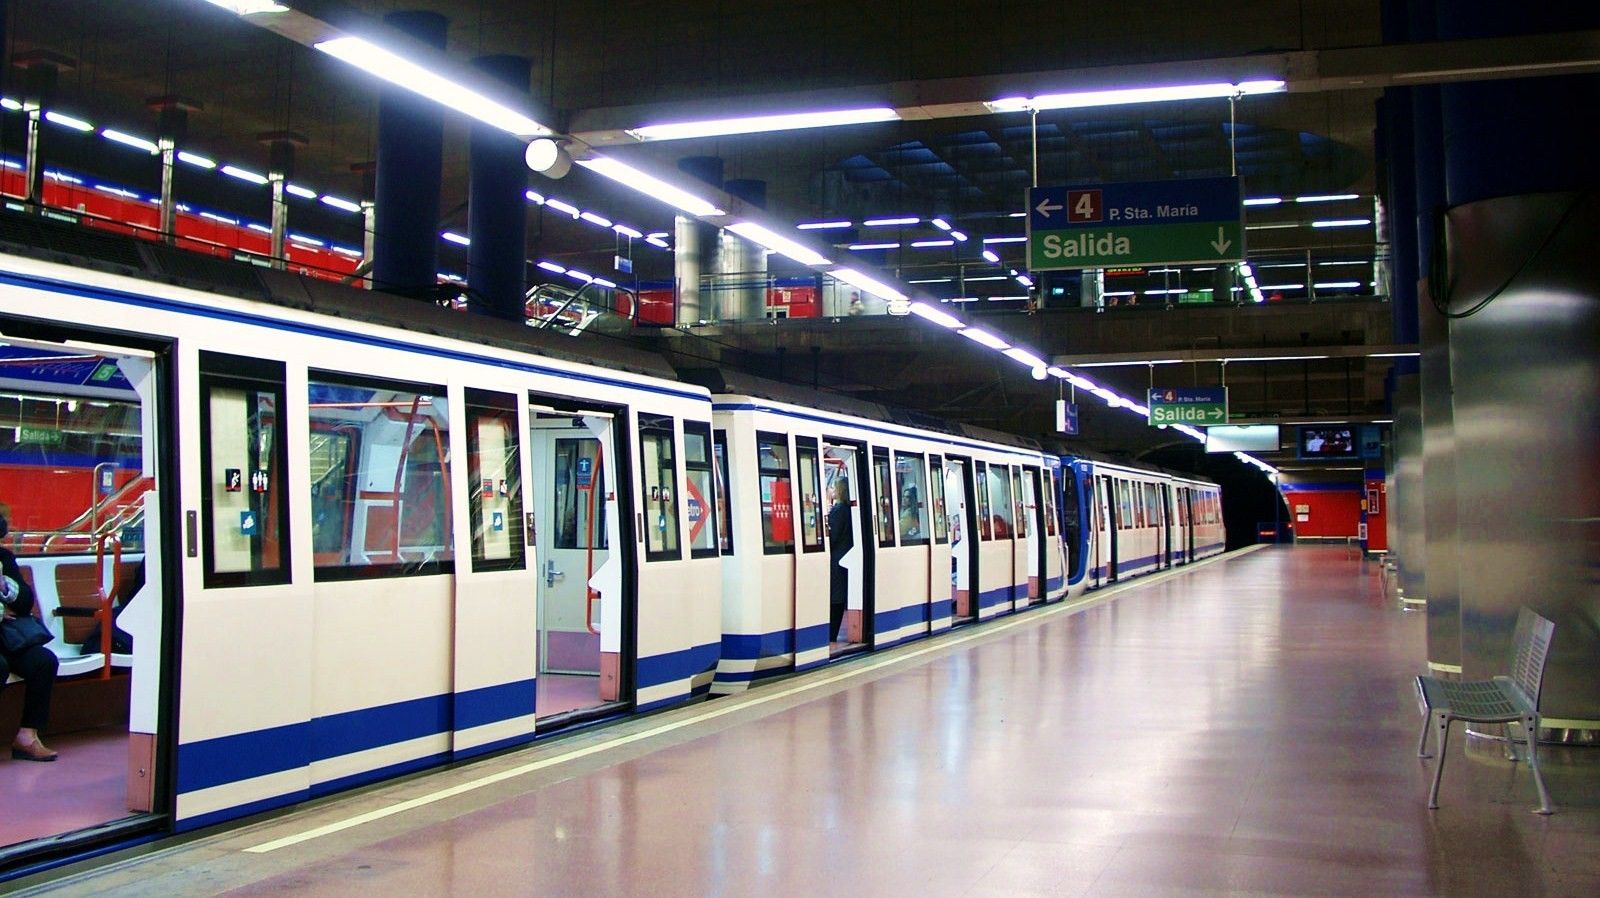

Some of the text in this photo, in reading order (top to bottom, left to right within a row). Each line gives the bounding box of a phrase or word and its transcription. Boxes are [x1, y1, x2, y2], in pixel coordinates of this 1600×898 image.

[1075, 193, 1094, 219] 4
[1109, 207, 1121, 221] P.
[1124, 206, 1152, 220] Sta.
[1043, 232, 1130, 259] Salida
[1165, 391, 1173, 401] 4
[1154, 407, 1205, 421] Salida
[22, 429, 50, 440] Salida
